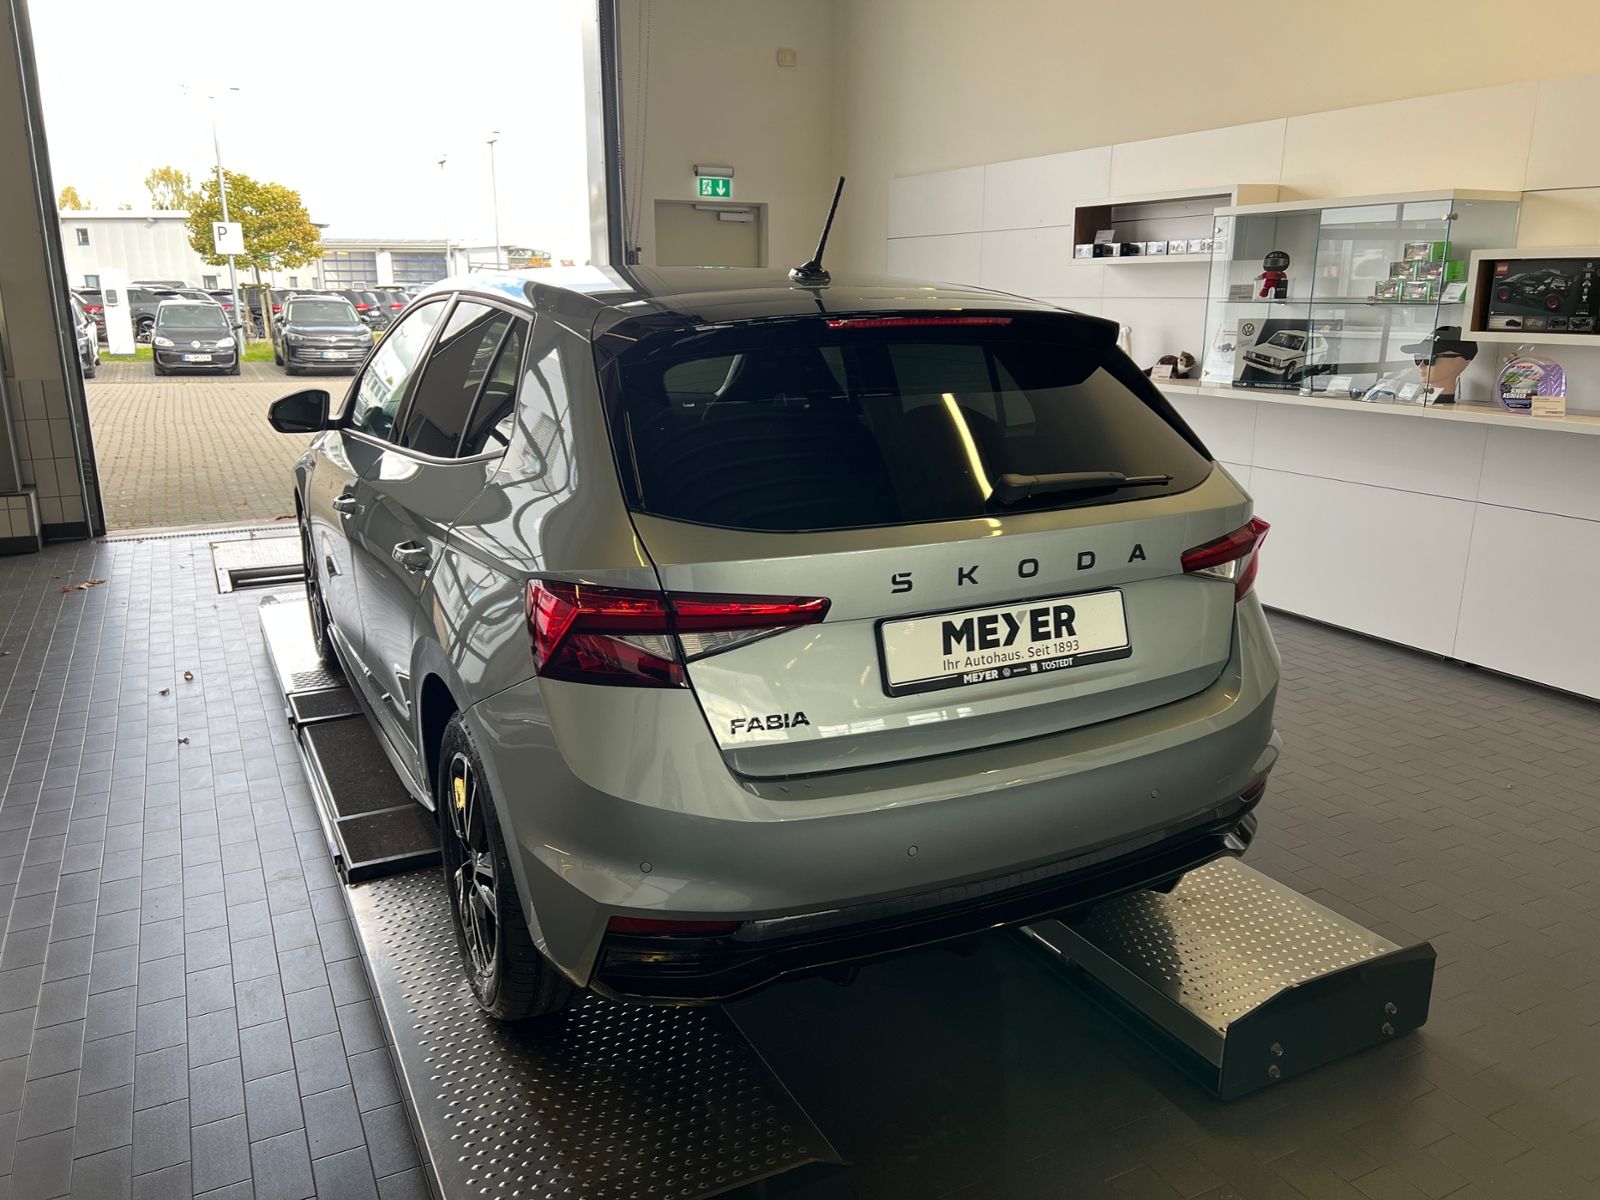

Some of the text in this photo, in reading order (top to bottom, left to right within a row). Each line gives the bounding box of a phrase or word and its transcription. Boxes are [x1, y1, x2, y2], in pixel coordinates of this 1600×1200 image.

[217, 226, 228, 241] P
[943, 604, 1076, 656] MEYER
[943, 657, 961, 671] Ihr
[964, 650, 1024, 669] Autohaus.
[1027, 645, 1051, 659] Seit
[1053, 640, 1080, 655] 1893
[963, 670, 999, 684] MEYER
[1041, 657, 1074, 670] TOSTEDT
[730, 711, 810, 735] FABIA
